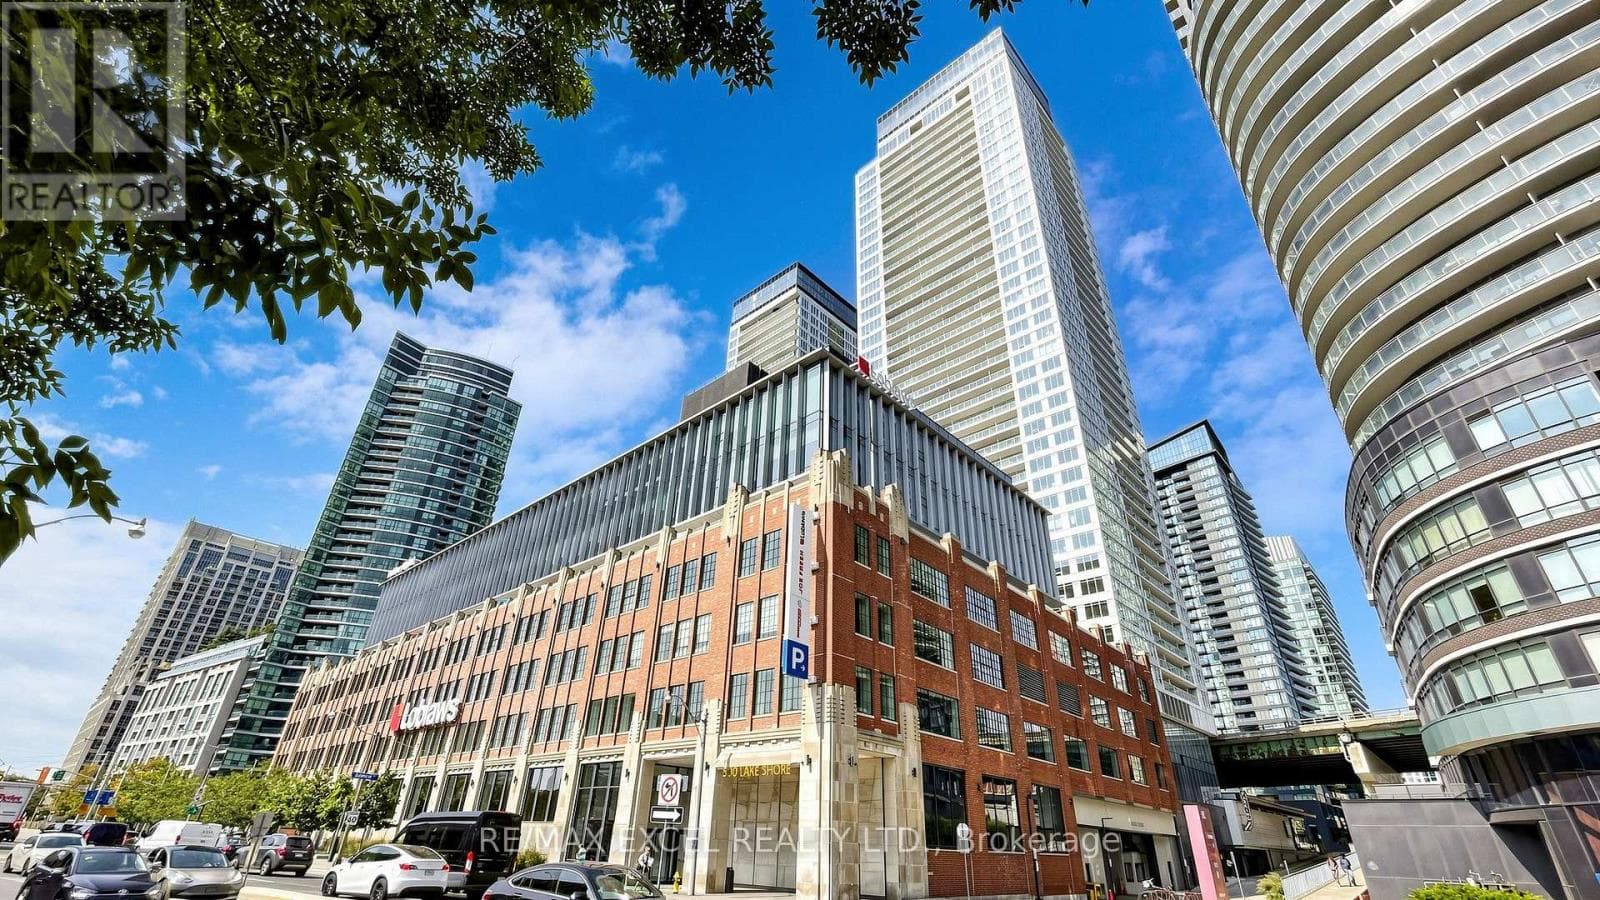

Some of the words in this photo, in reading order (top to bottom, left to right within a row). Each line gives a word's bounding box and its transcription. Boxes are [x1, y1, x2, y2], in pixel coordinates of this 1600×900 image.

[791, 646, 805, 670] P
[399, 698, 460, 731] Loblaws
[739, 766, 760, 777] LAKE
[761, 764, 791, 776] SHORE
